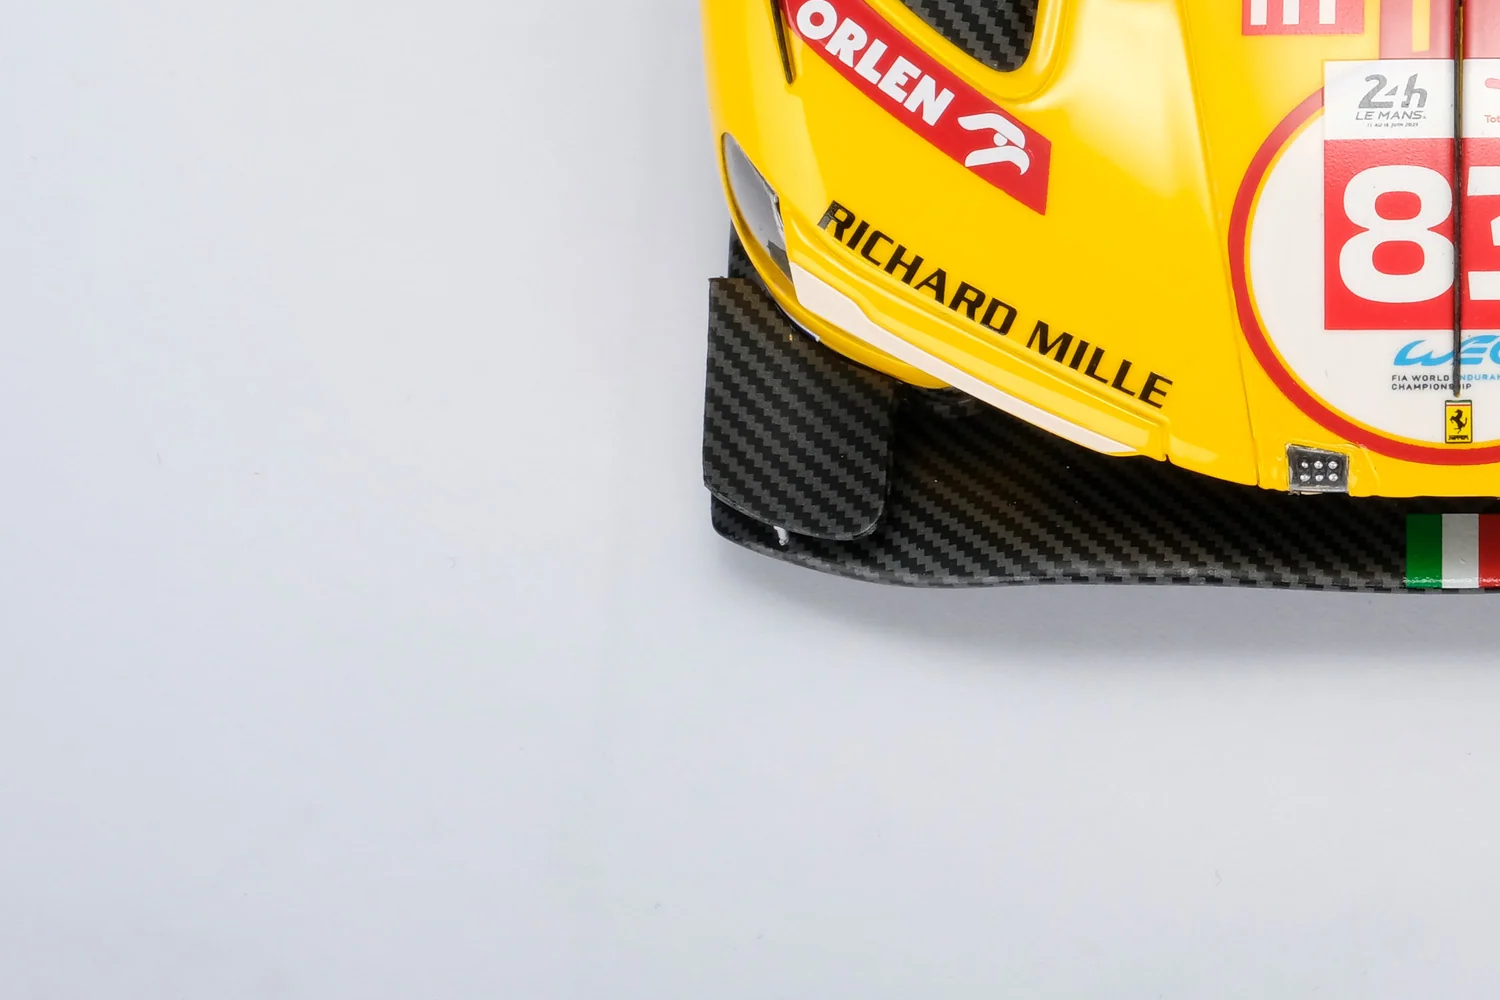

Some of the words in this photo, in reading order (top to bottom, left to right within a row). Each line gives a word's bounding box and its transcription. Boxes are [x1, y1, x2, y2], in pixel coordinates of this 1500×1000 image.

[1355, 110, 1375, 121] LE
[1378, 110, 1424, 120] MANS
[816, 200, 1018, 336] RICHARD
[1025, 320, 1174, 409] MILLE
[1391, 374, 1408, 382] FIA
[1411, 374, 1450, 382] WORLD
